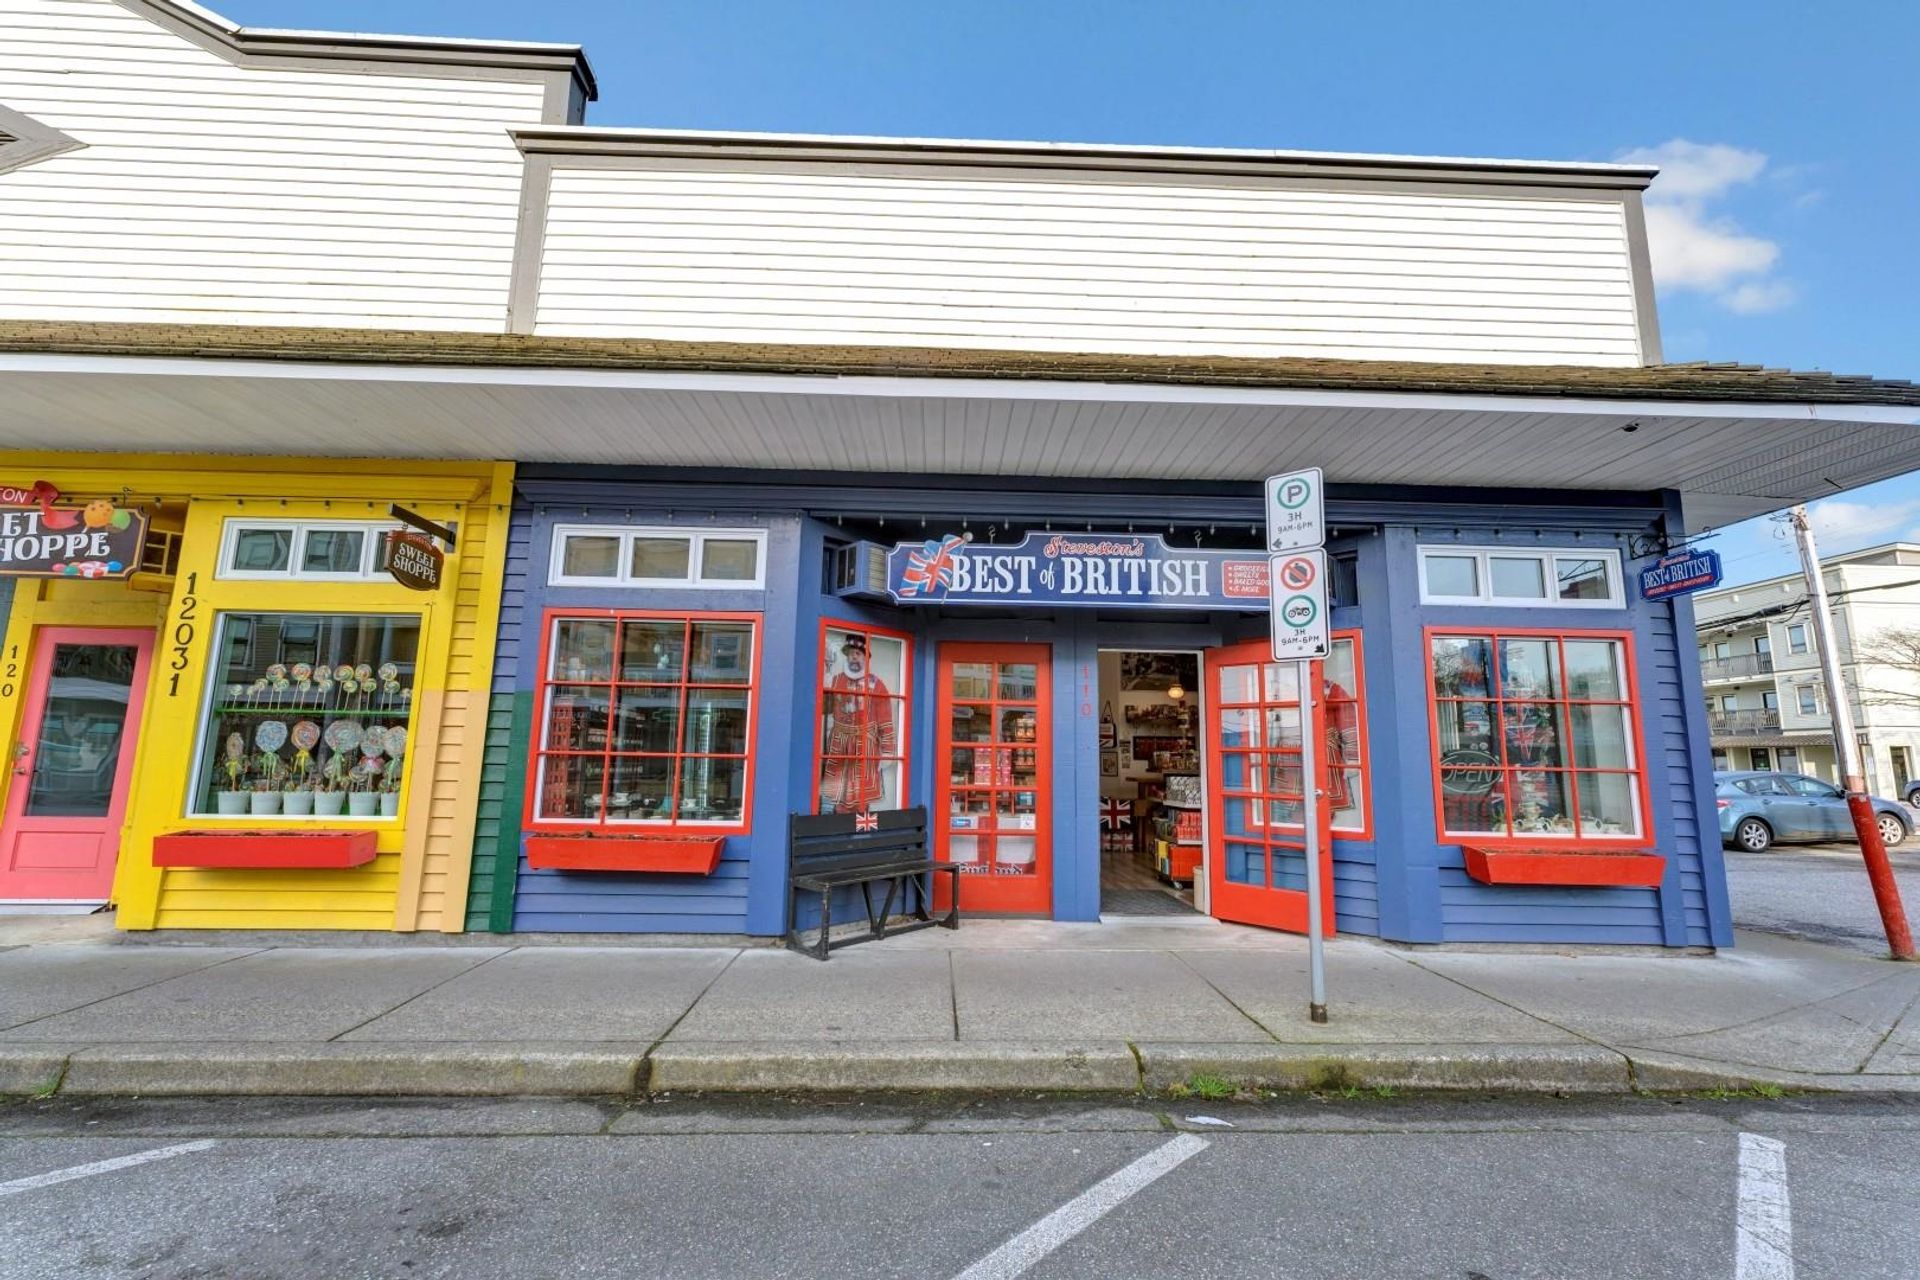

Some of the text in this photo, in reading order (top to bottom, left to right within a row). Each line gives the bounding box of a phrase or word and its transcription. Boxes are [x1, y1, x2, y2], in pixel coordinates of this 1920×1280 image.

[1288, 511, 1302, 522] 3H
[399, 542, 436, 569] SWEET
[1043, 535, 1145, 558] Steveston's
[393, 553, 437, 583] SHOPPE
[950, 555, 1210, 597] BEST of BRITISH
[1643, 567, 1666, 589] BEST
[1670, 556, 1712, 582] BRITISH
[169, 572, 197, 697] 12031
[1281, 635, 1320, 646] 9AM-6PM
[1294, 628, 1306, 637] 3H
